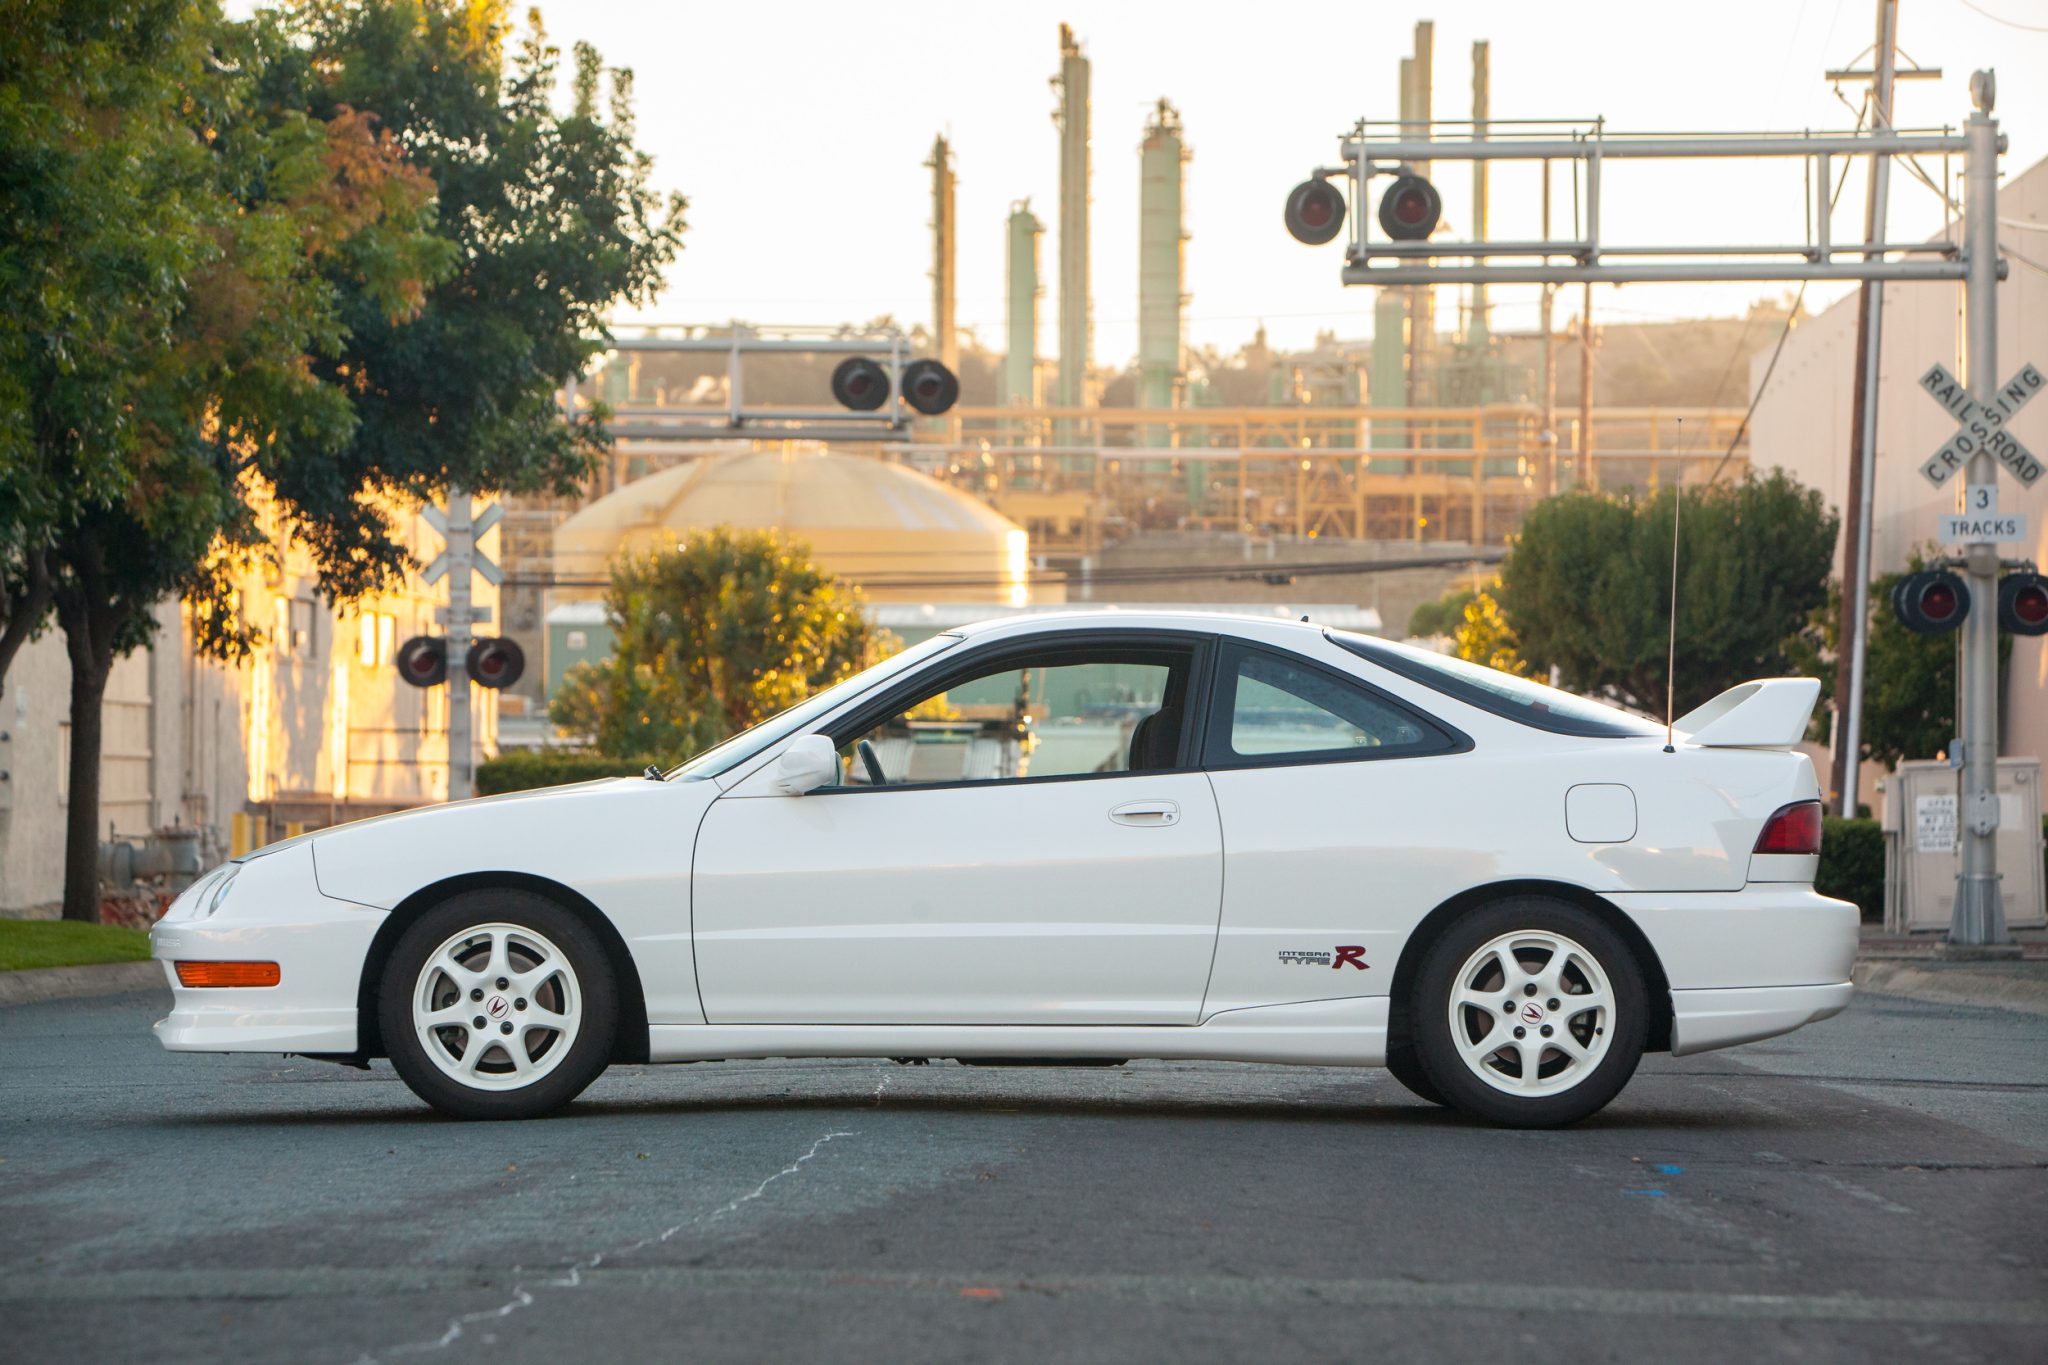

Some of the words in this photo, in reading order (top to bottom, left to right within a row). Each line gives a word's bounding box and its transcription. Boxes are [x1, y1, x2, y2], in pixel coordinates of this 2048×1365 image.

[1927, 368, 2041, 482] CROSSING
[1975, 488, 1989, 509] 3
[1950, 519, 2016, 536] TRACKS
[1279, 956, 1331, 965] TYPE
[1331, 945, 1371, 971] R
